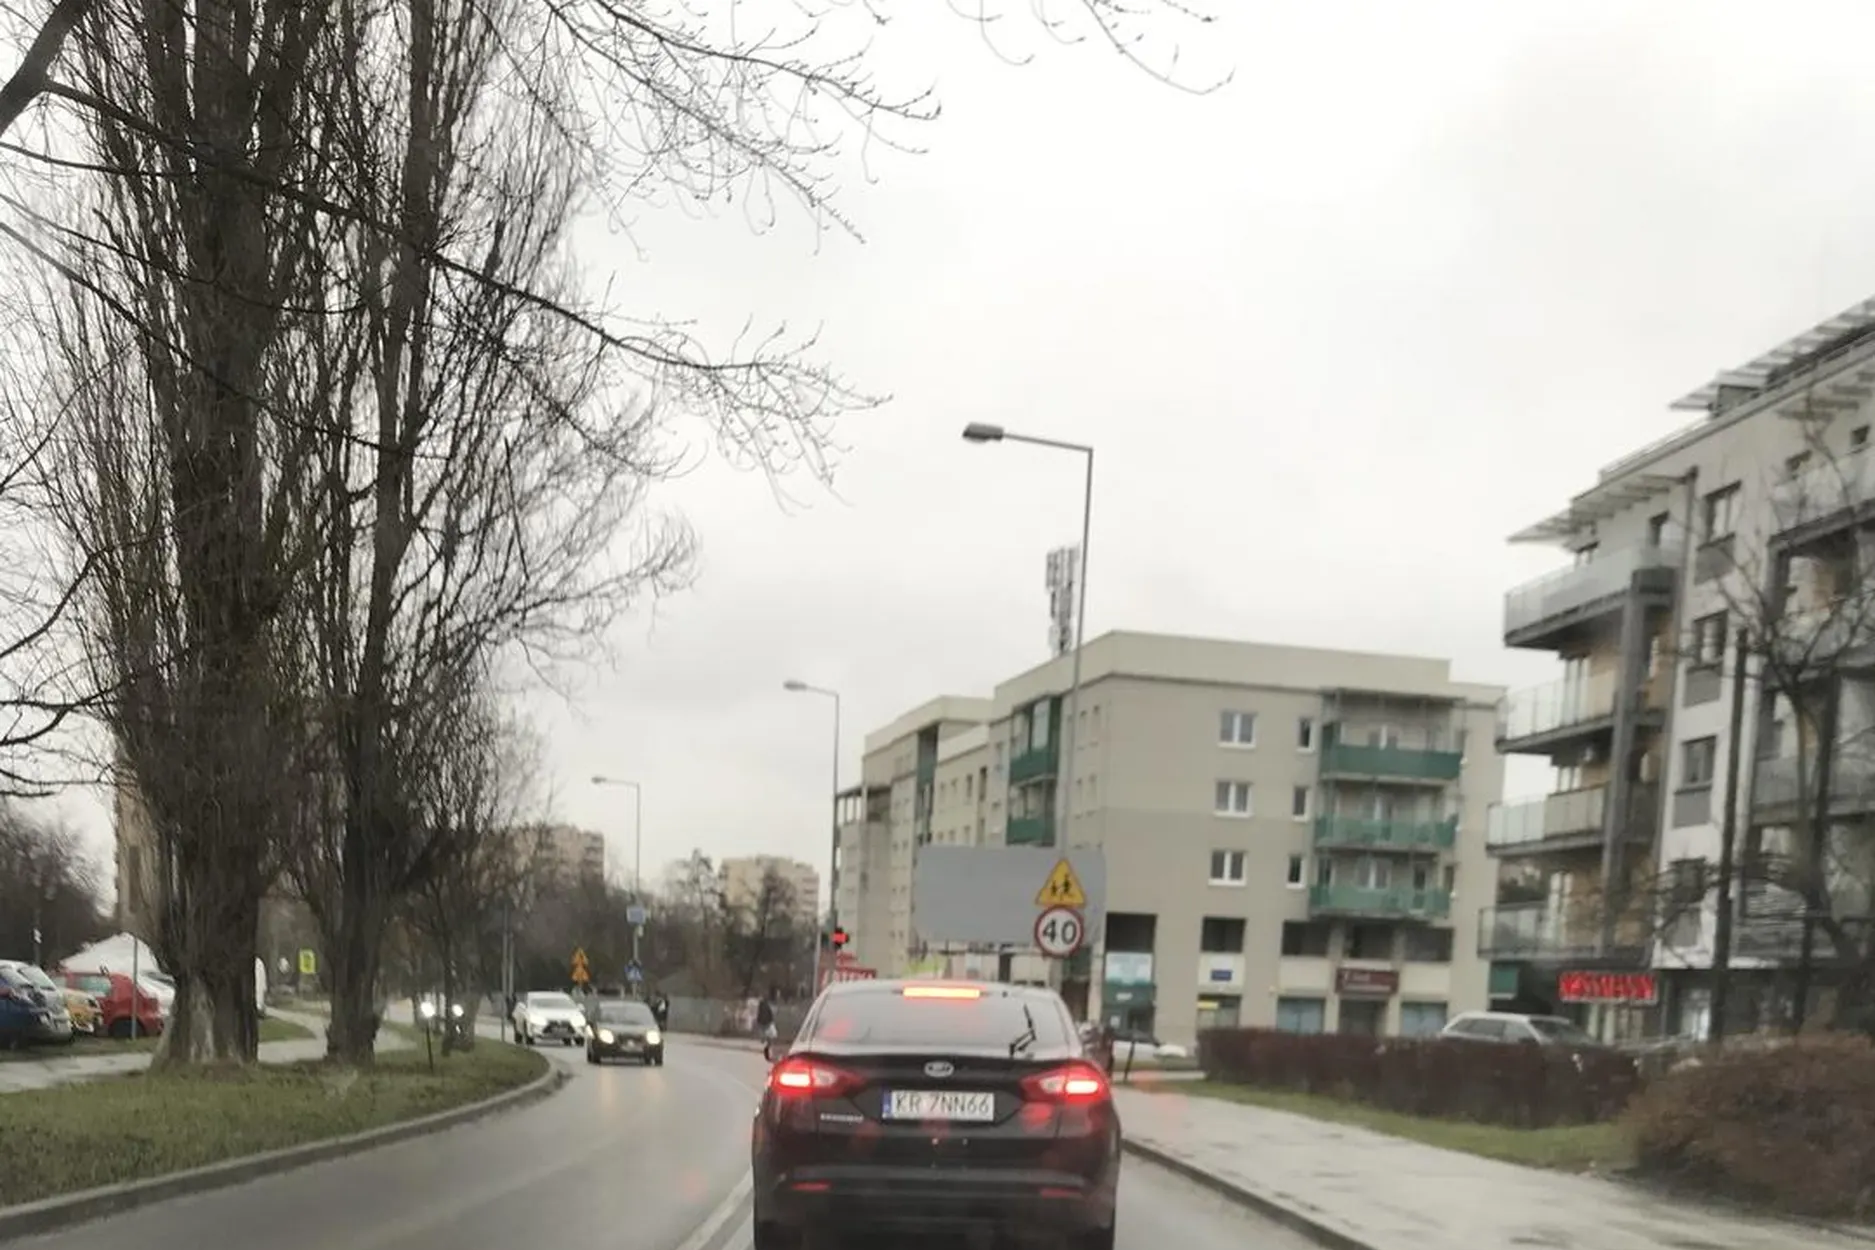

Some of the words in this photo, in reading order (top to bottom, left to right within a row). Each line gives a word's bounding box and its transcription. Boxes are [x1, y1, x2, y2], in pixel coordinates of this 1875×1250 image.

[1042, 917, 1077, 945] 40
[895, 1091, 922, 1112] KR
[929, 1092, 990, 1114] 7NN66
